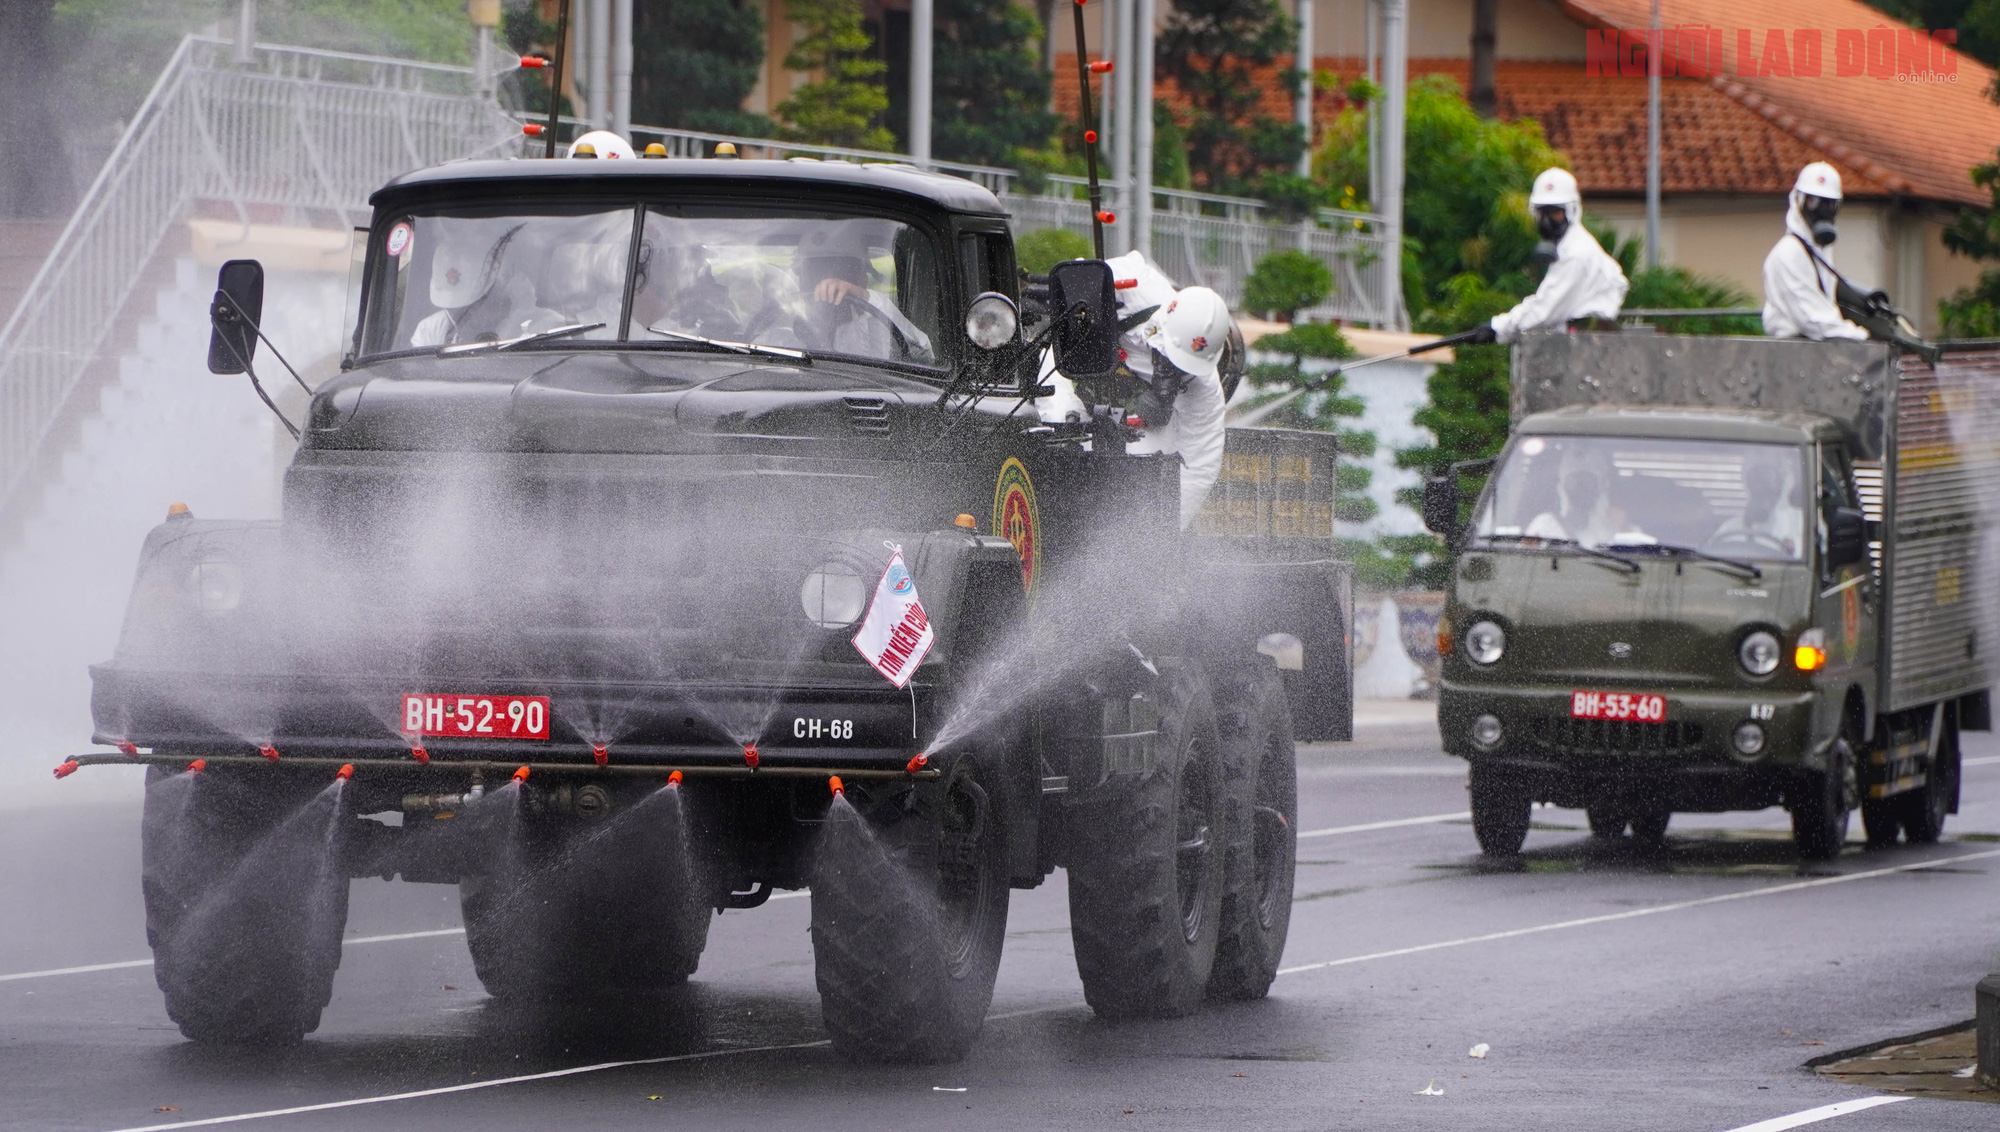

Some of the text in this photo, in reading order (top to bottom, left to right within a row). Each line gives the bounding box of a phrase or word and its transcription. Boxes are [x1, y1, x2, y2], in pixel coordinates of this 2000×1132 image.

[888, 623, 922, 659] KIẾM
[878, 648, 906, 677] TÌM
[406, 697, 544, 734] BH-52-90
[1573, 692, 1663, 720] BH-53-60
[793, 717, 854, 739] CH-68
